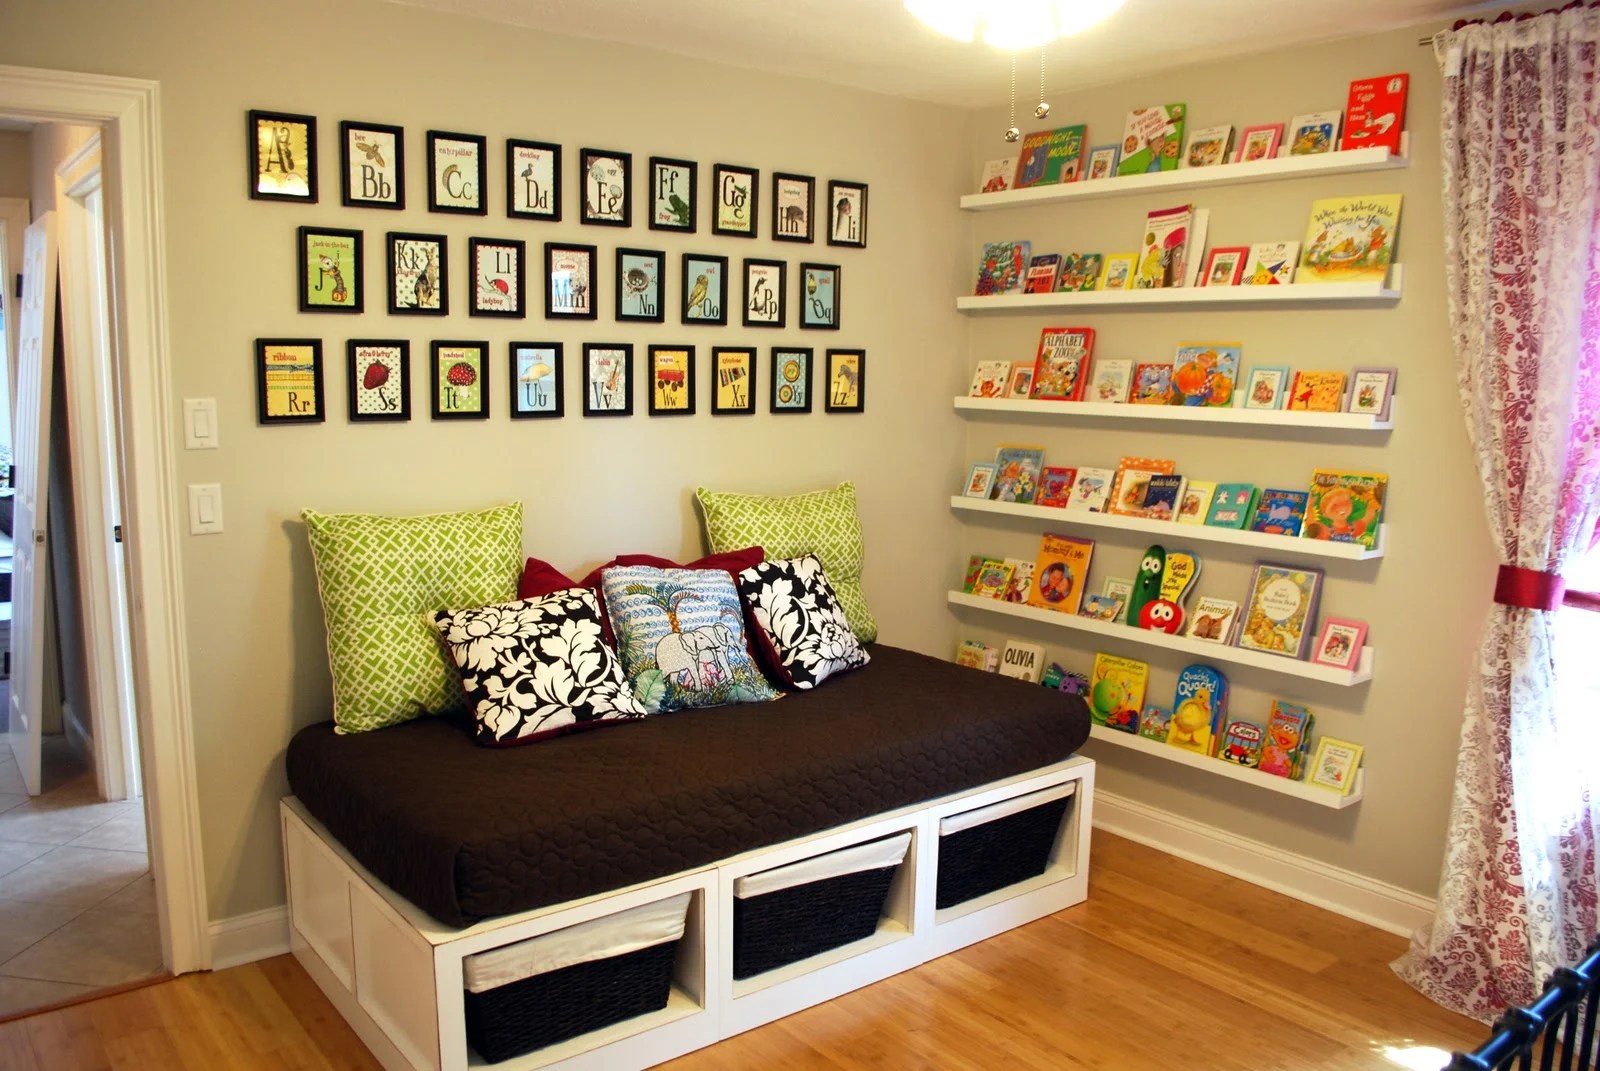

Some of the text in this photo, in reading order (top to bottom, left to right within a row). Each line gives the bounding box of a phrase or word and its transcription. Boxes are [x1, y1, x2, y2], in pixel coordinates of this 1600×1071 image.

[354, 132, 366, 141] bee
[1023, 131, 1073, 149] GOODNIGHT
[361, 164, 391, 199] Bb
[446, 170, 472, 200] Cc
[658, 167, 679, 200] Ff
[526, 179, 548, 209] Dd
[597, 181, 619, 215] Ee
[723, 174, 747, 219] Gg
[397, 242, 420, 270] Kk
[639, 294, 655, 315] Nn
[1046, 334, 1084, 347] ALPHABET
[272, 352, 297, 361] ribbon
[1053, 347, 1071, 358] ZOO
[288, 391, 310, 412] Rr
[378, 386, 397, 411] Ss
[443, 386, 460, 409] Tt
[526, 383, 548, 407] Uu
[592, 381, 612, 409] Vv
[662, 389, 678, 407] Ww
[731, 384, 746, 407] Xx
[832, 381, 848, 406] Zz
[1171, 562, 1188, 570] God
[1199, 603, 1233, 615] Animals
[1004, 647, 1035, 669] OLIVIA
[1233, 726, 1257, 738] Colors
